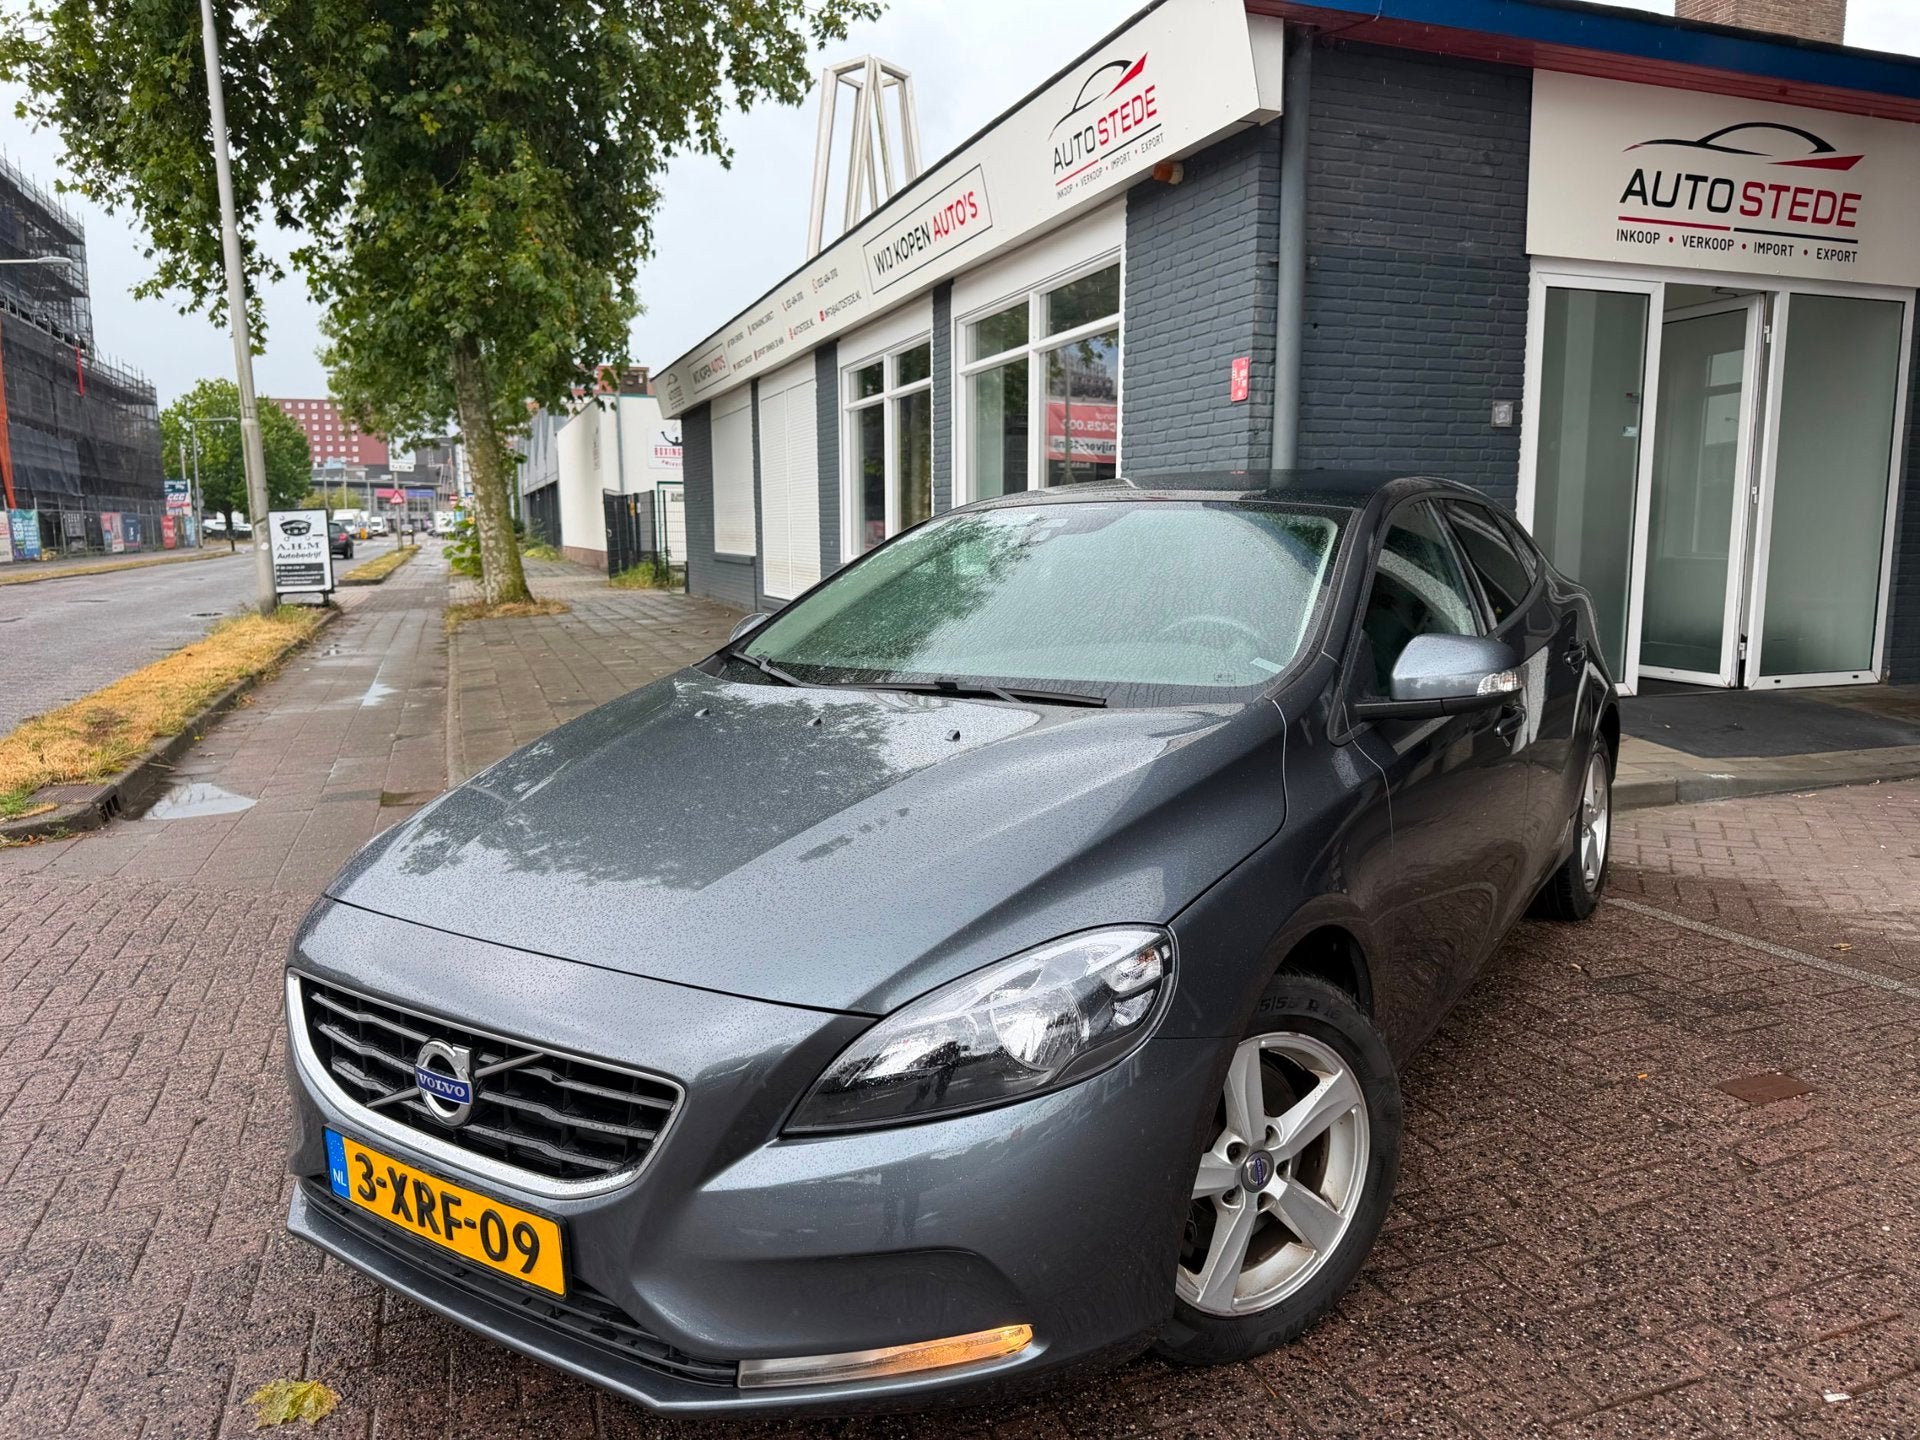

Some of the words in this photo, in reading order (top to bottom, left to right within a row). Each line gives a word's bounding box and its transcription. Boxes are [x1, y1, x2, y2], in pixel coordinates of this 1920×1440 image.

[1053, 84, 1158, 175] AUTOSTEDE
[1056, 184, 1074, 200] INKOOP
[1080, 167, 1103, 187] VERKOOP
[1110, 151, 1131, 170] IMPORT
[1141, 133, 1164, 154] EXPORT
[1619, 168, 1862, 228] AUTOSTEDE
[873, 246, 894, 275] WIJ
[893, 222, 932, 264] KOPEN
[933, 191, 978, 242] AUTO'S
[1616, 229, 1661, 245] INKOOP
[1681, 235, 1735, 251] VERKOOP
[1753, 242, 1795, 257] IMPORT
[1816, 248, 1858, 263] EXPORT
[277, 551, 322, 560] Autobedrijf
[417, 1071, 466, 1098] VOLVO
[333, 1170, 347, 1187] NL
[355, 1153, 540, 1274] 3-XRF-09
